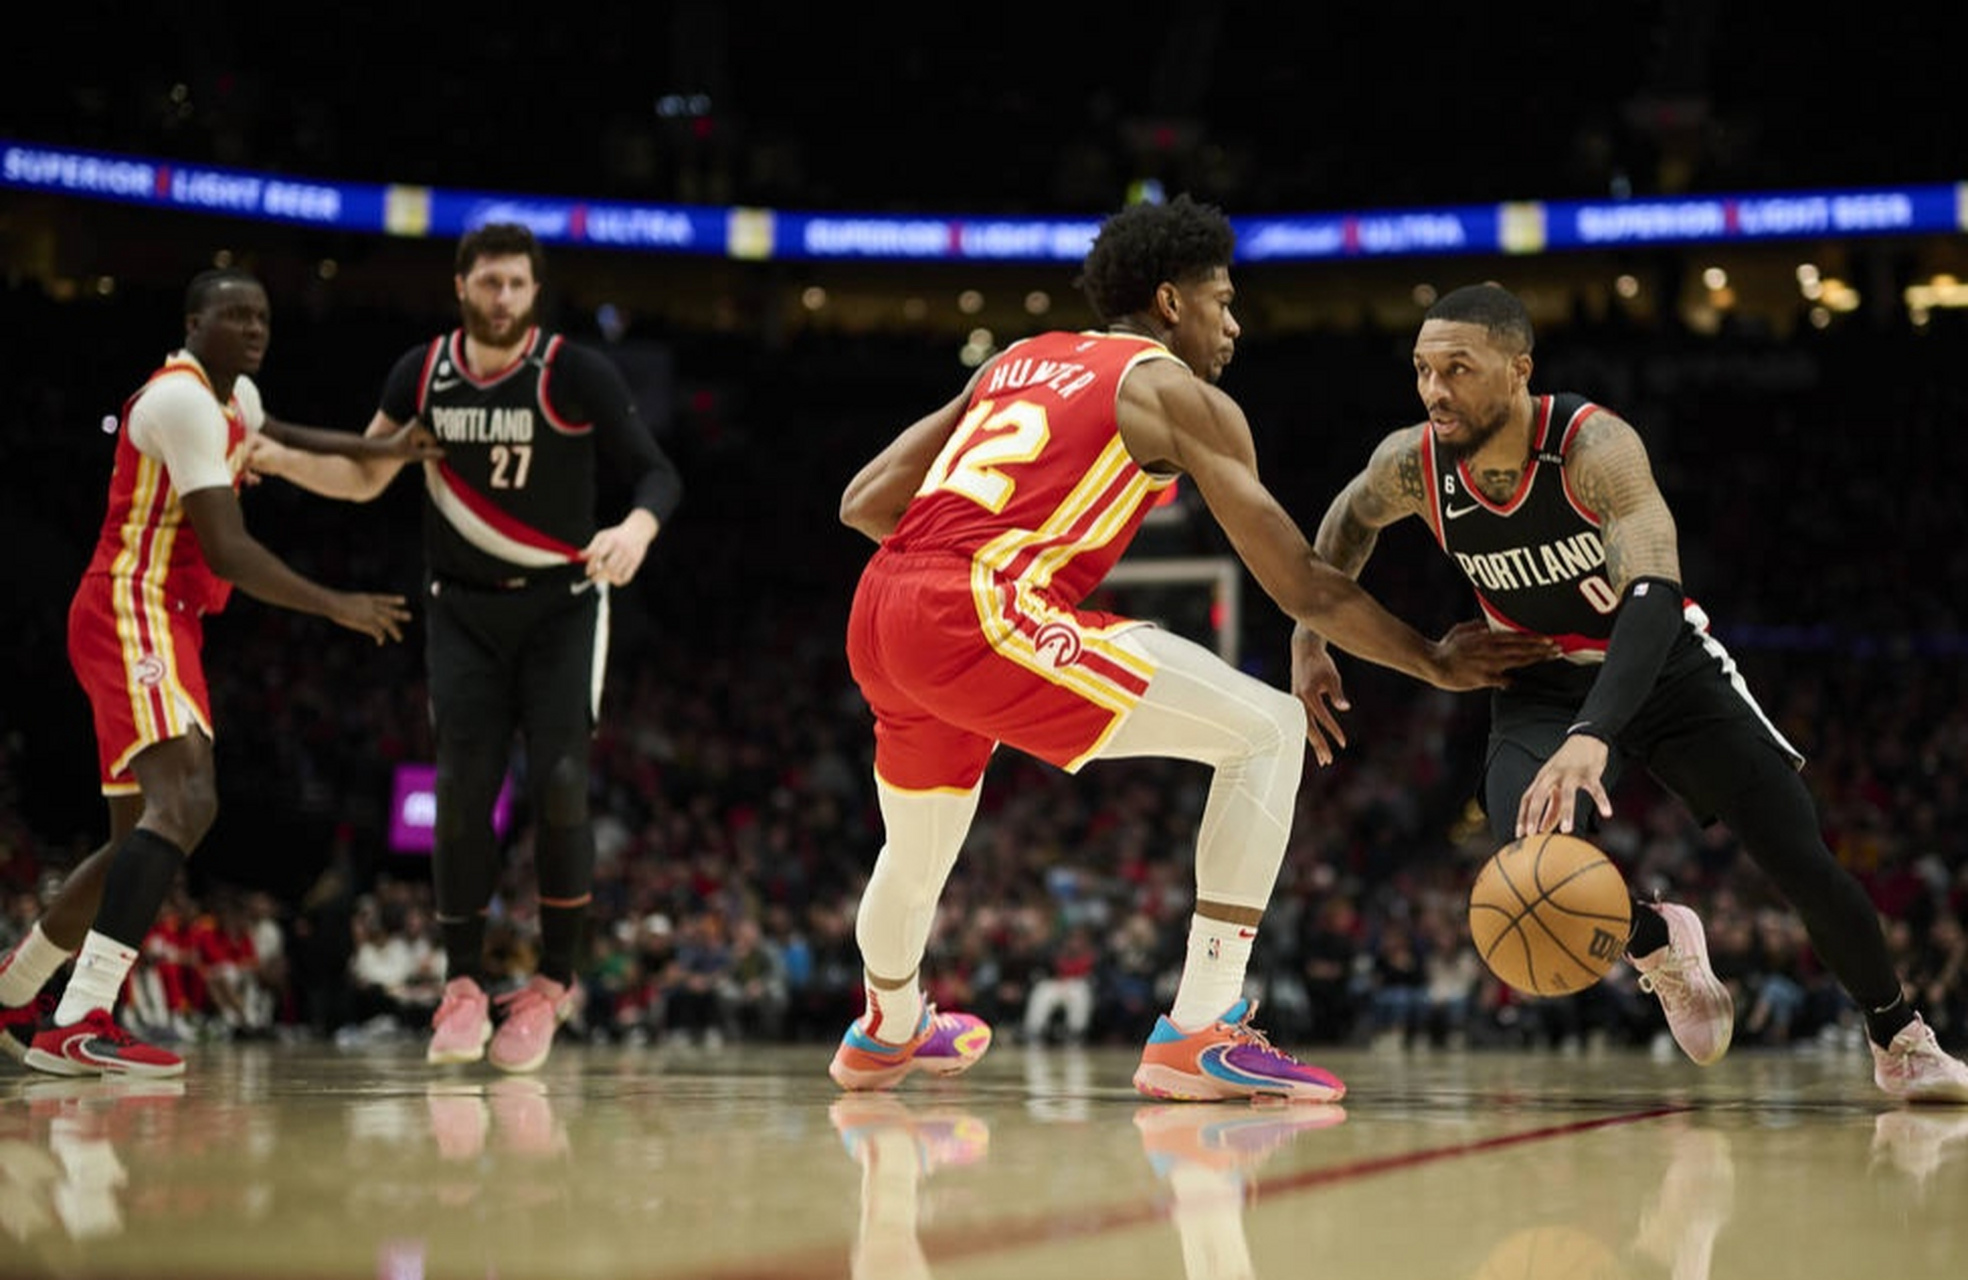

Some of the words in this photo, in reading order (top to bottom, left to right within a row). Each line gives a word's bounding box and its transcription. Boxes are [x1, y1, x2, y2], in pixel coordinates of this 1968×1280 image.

[3, 147, 155, 197] SUPERIOR
[172, 168, 260, 211] LIGHT
[264, 179, 340, 221] BEER
[1577, 202, 1724, 243] SUPERIOR
[1739, 197, 1828, 234] LIGHT
[1832, 193, 1912, 230] BEER
[431, 406, 533, 442] PORTLAND
[490, 444, 533, 489] 27
[914, 400, 1051, 515] 12
[1444, 474, 1455, 494] 6
[1455, 532, 1605, 590] PORTLAND
[1579, 575, 1619, 614] 0
